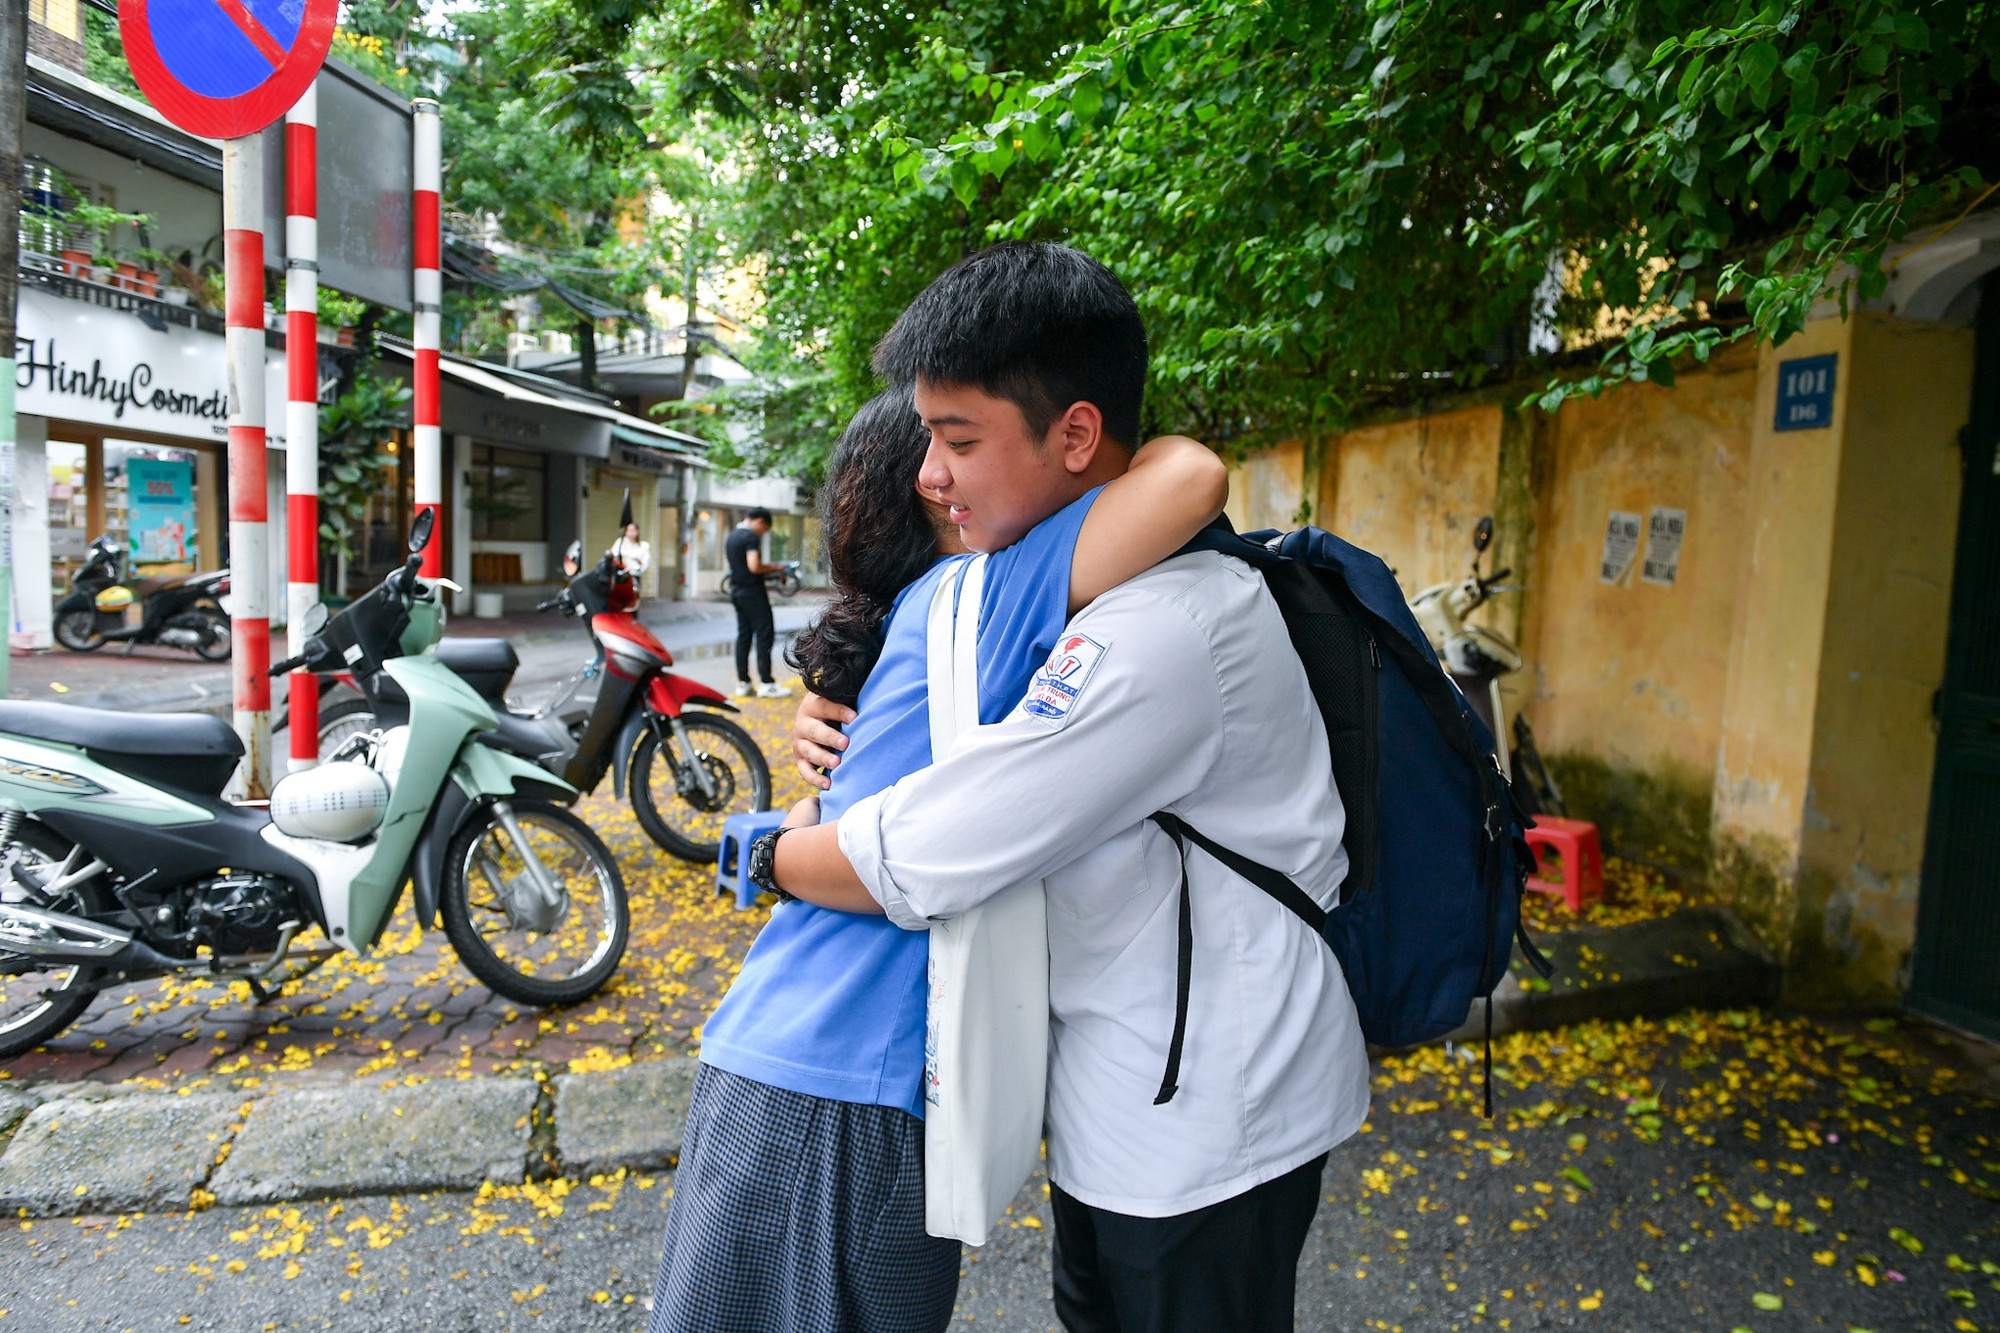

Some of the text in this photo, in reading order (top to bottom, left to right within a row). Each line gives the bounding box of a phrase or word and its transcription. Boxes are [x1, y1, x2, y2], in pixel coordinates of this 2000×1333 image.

[1786, 367, 1827, 397] 101
[146, 480, 174, 495] 50%
[1046, 686, 1072, 702] TRUNG
